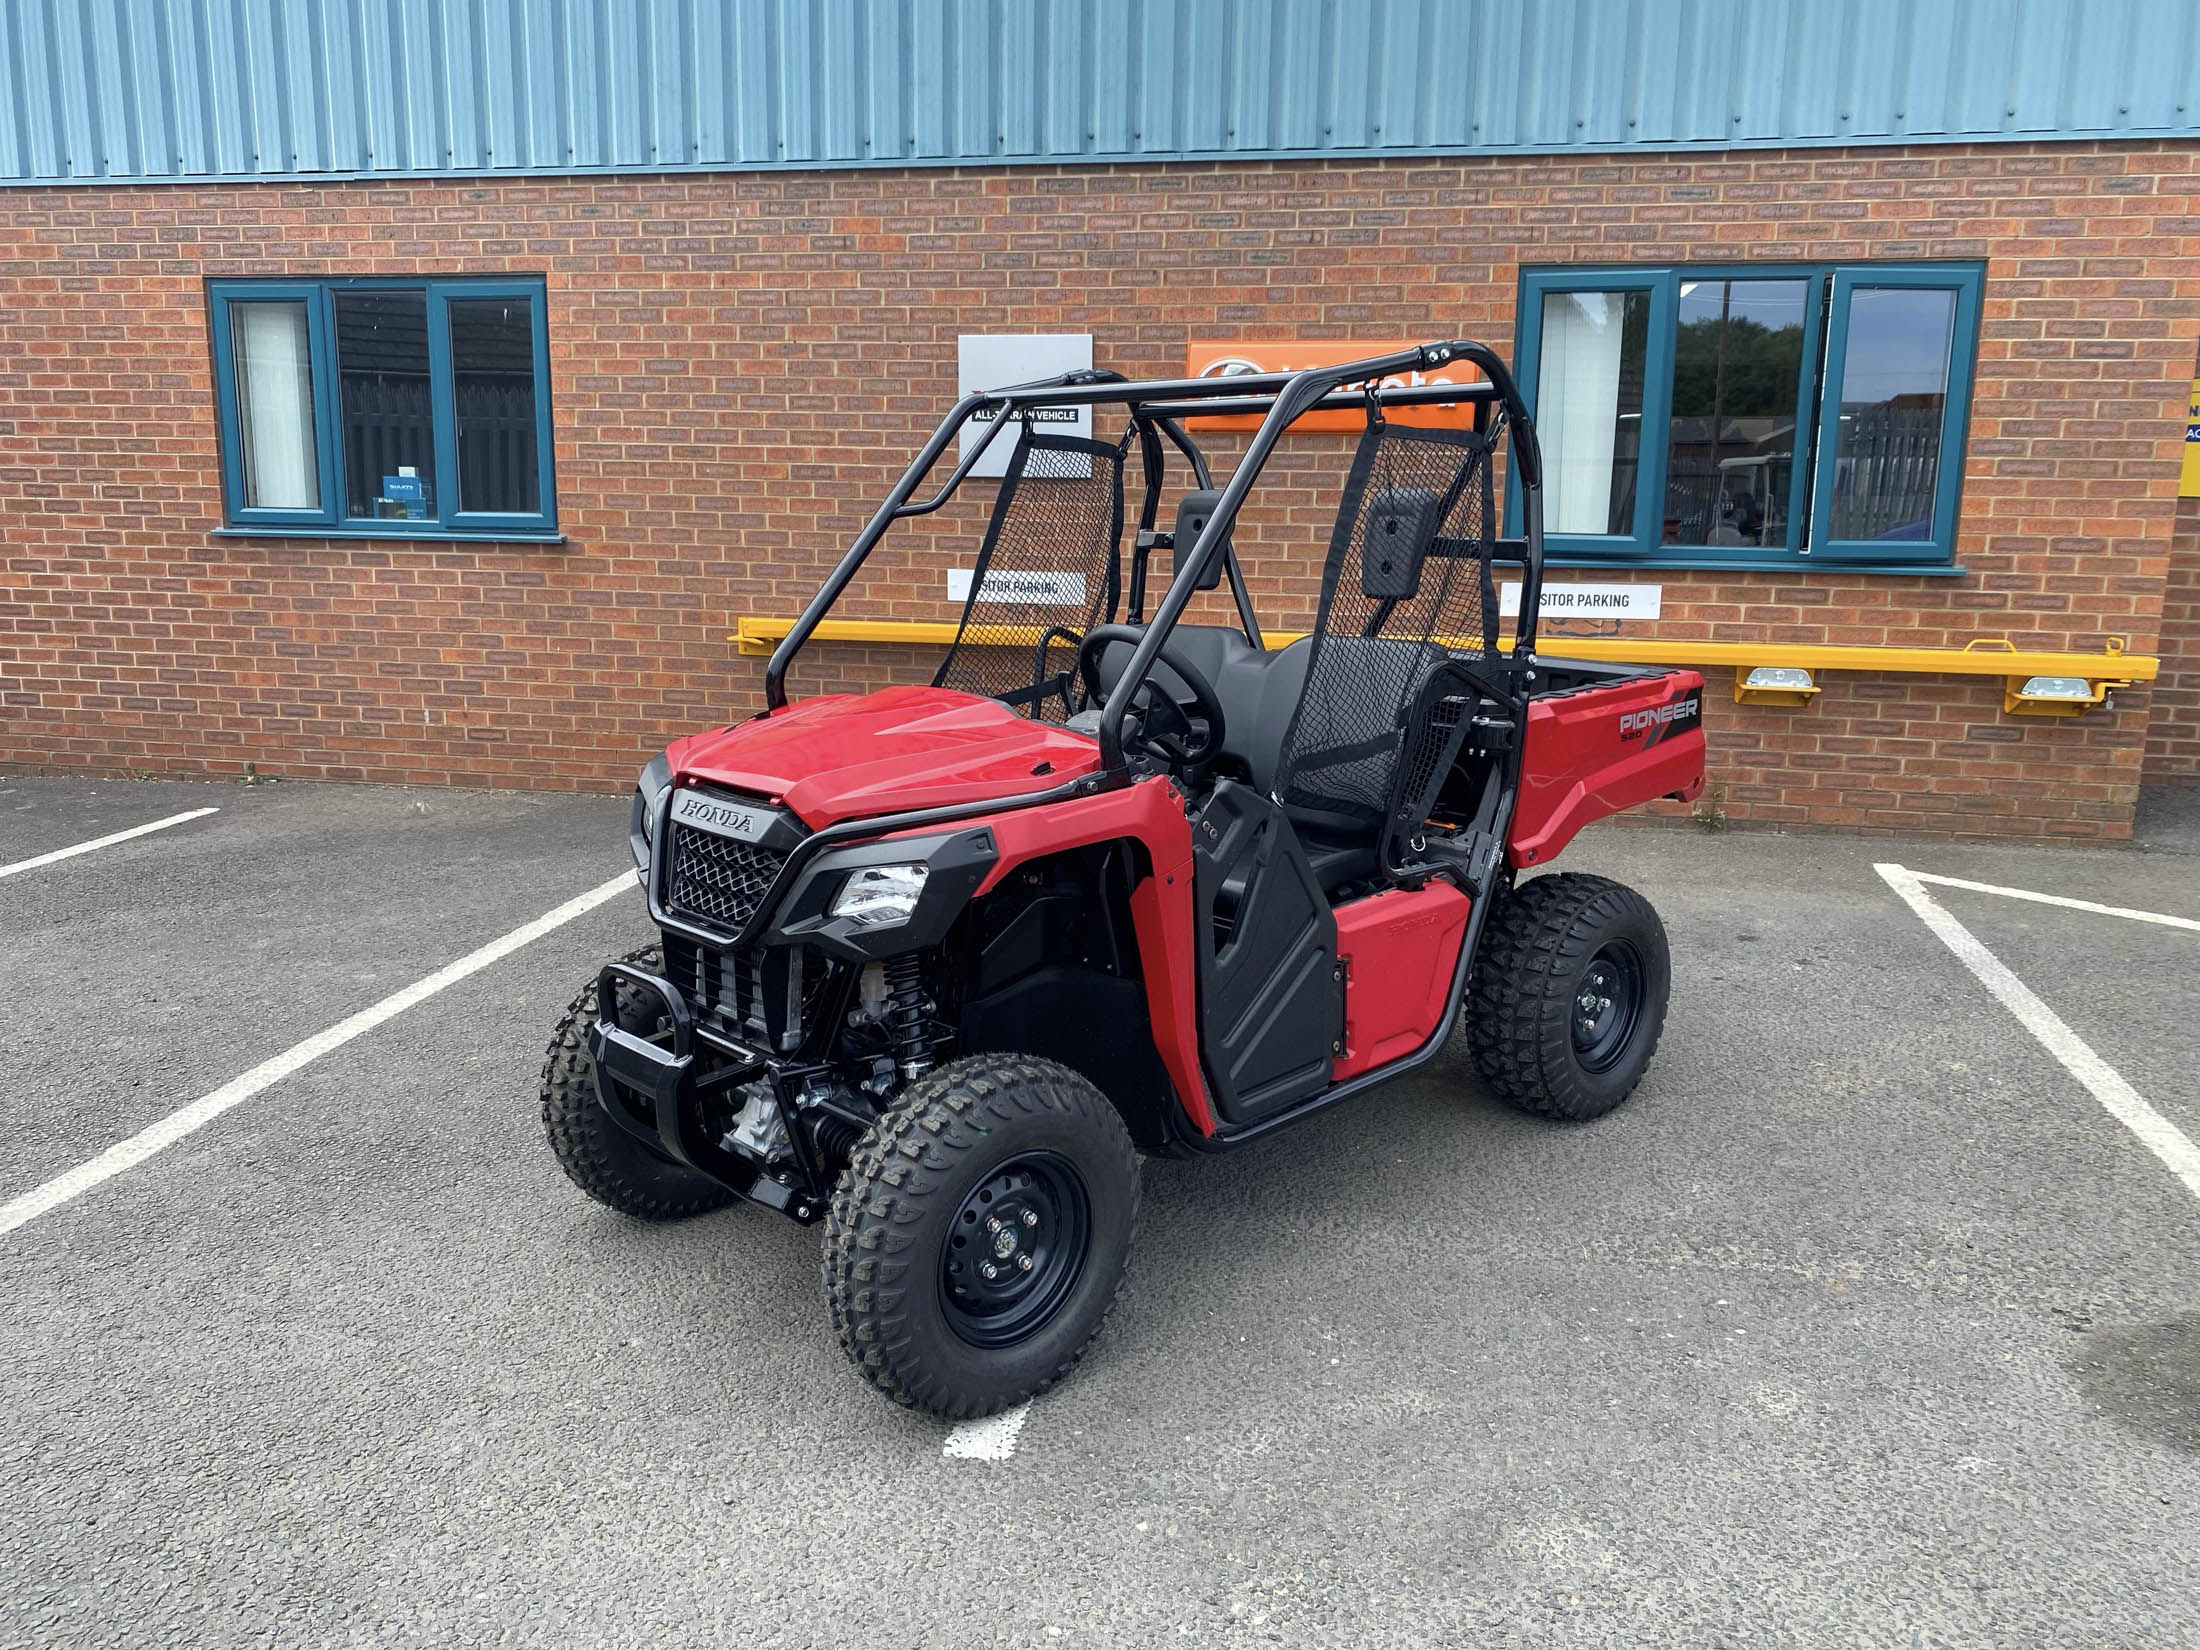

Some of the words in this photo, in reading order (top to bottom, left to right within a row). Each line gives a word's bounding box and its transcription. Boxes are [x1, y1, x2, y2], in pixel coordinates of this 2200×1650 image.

[1037, 410, 1076, 421] VEHICLE
[981, 580, 1010, 593] SITOR
[1014, 581, 1059, 594] PARKING
[1540, 593, 1574, 607] SITOR
[1577, 594, 1630, 608] PARKING
[1620, 698, 1698, 733] PIONEER
[680, 799, 754, 832] HONDA
